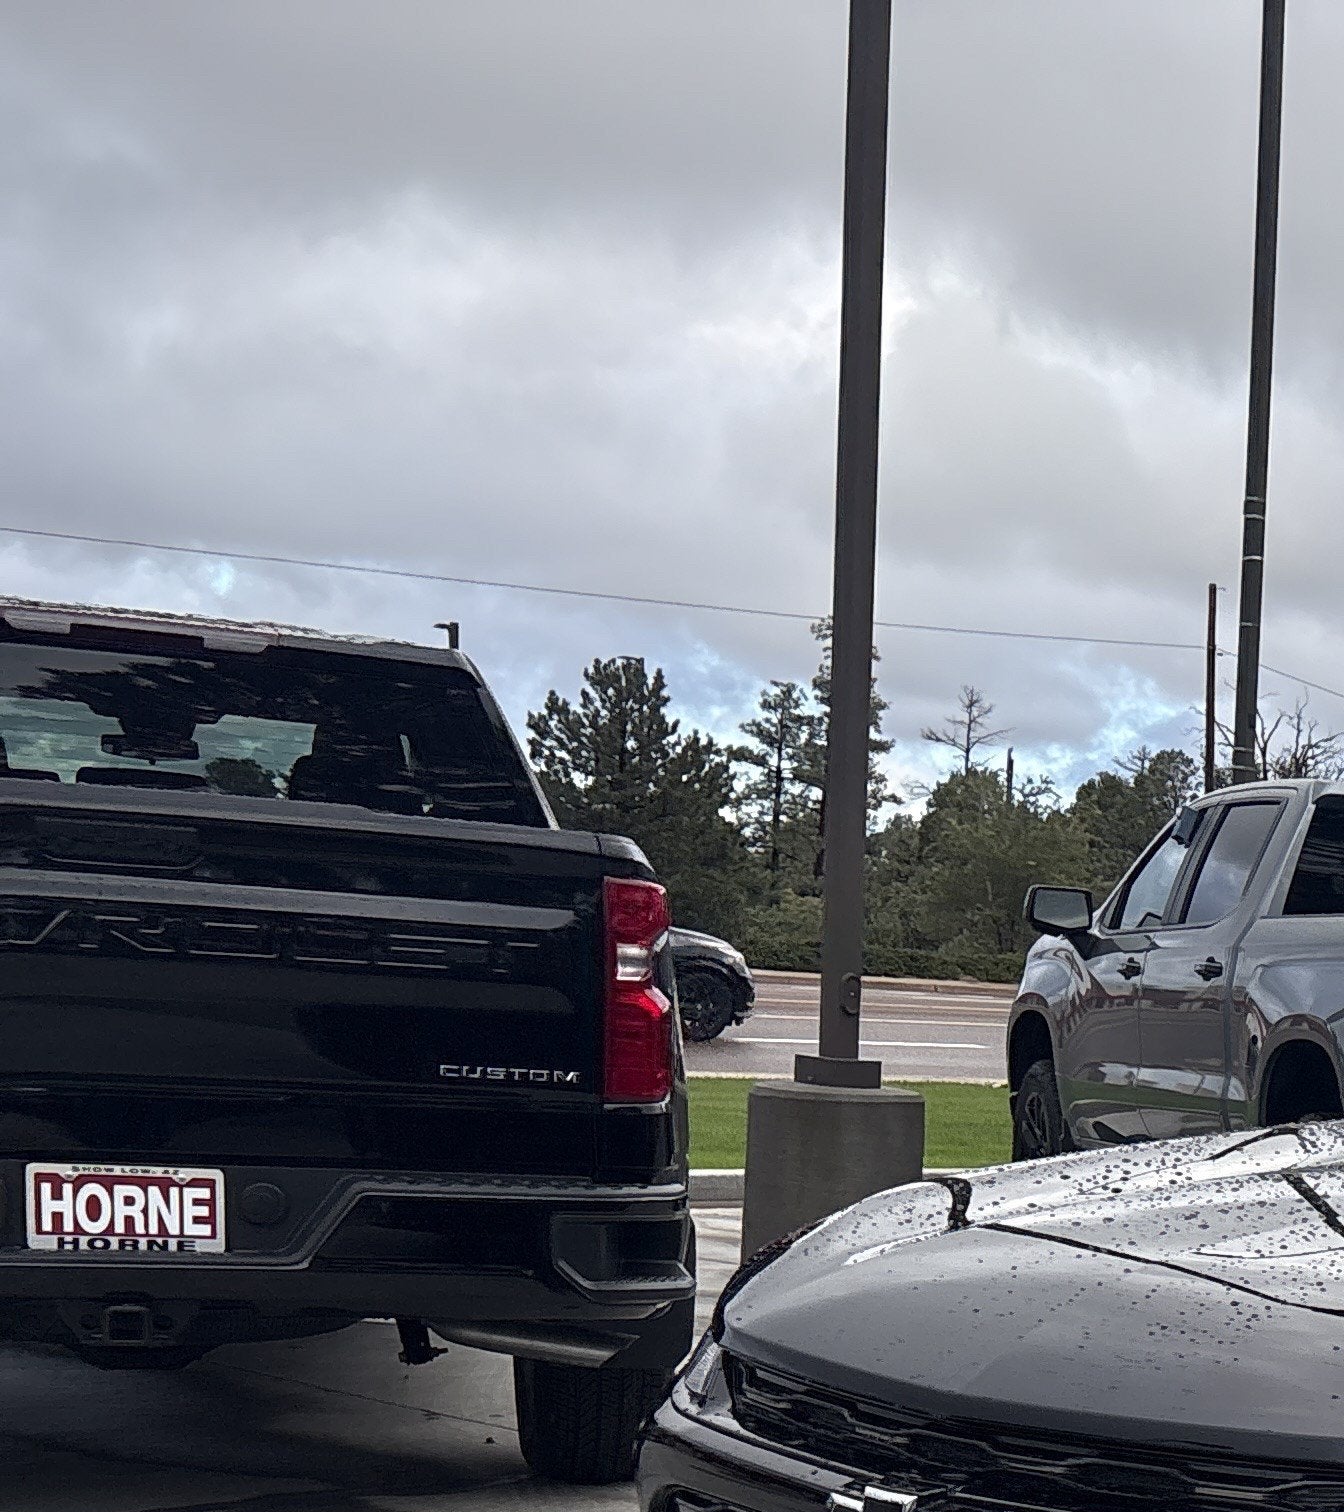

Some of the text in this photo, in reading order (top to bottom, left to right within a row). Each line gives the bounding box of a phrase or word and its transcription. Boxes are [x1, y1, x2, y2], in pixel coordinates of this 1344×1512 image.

[439, 1064, 581, 1084] CUSTOM
[39, 1181, 212, 1237] HORNE
[57, 1236, 197, 1252] HORNE
